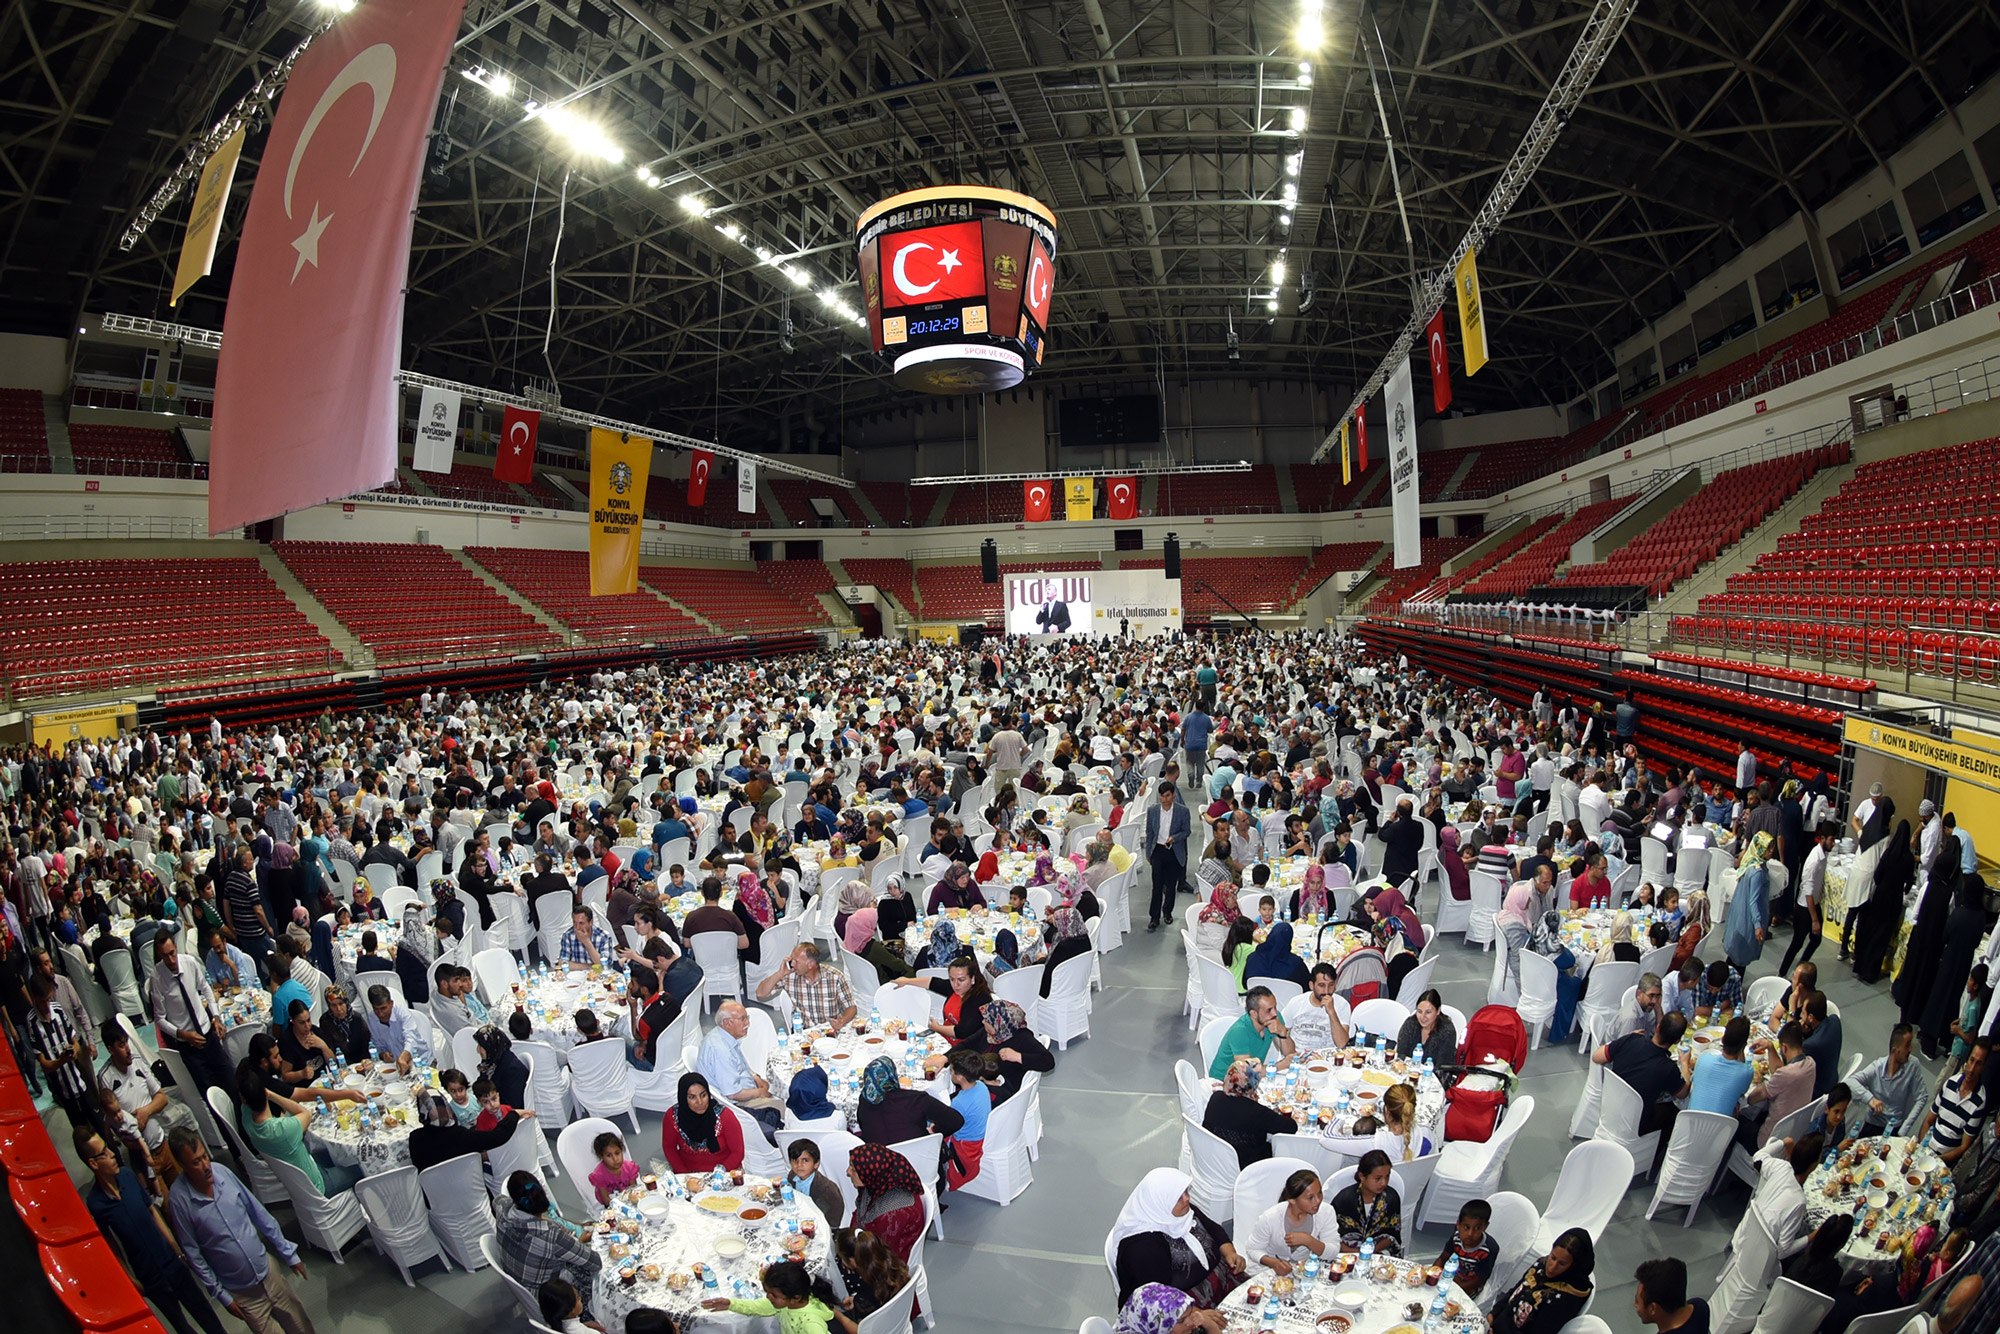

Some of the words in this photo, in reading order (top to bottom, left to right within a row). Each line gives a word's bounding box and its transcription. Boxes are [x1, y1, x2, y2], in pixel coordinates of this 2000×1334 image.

[888, 202, 973, 228] BELEDİYESİ
[909, 317, 960, 335] 20:12:29
[964, 347, 987, 356] SPOR
[988, 350, 998, 358] VE
[430, 421, 446, 429] KONYA
[377, 494, 397, 503] Kadar
[398, 496, 421, 506] Büyük,
[422, 498, 452, 508] Görkemli
[463, 502, 490, 512] Geleceğe
[608, 499, 630, 510] KONYA
[594, 508, 639, 526] BÜYÜKŞEHİR
[603, 525, 631, 534] BELEDİYESİ
[1126, 607, 1168, 618] buluşması
[1882, 733, 1907, 750] KONYA
[1908, 740, 1958, 766] BÜYÜKŞEHİR
